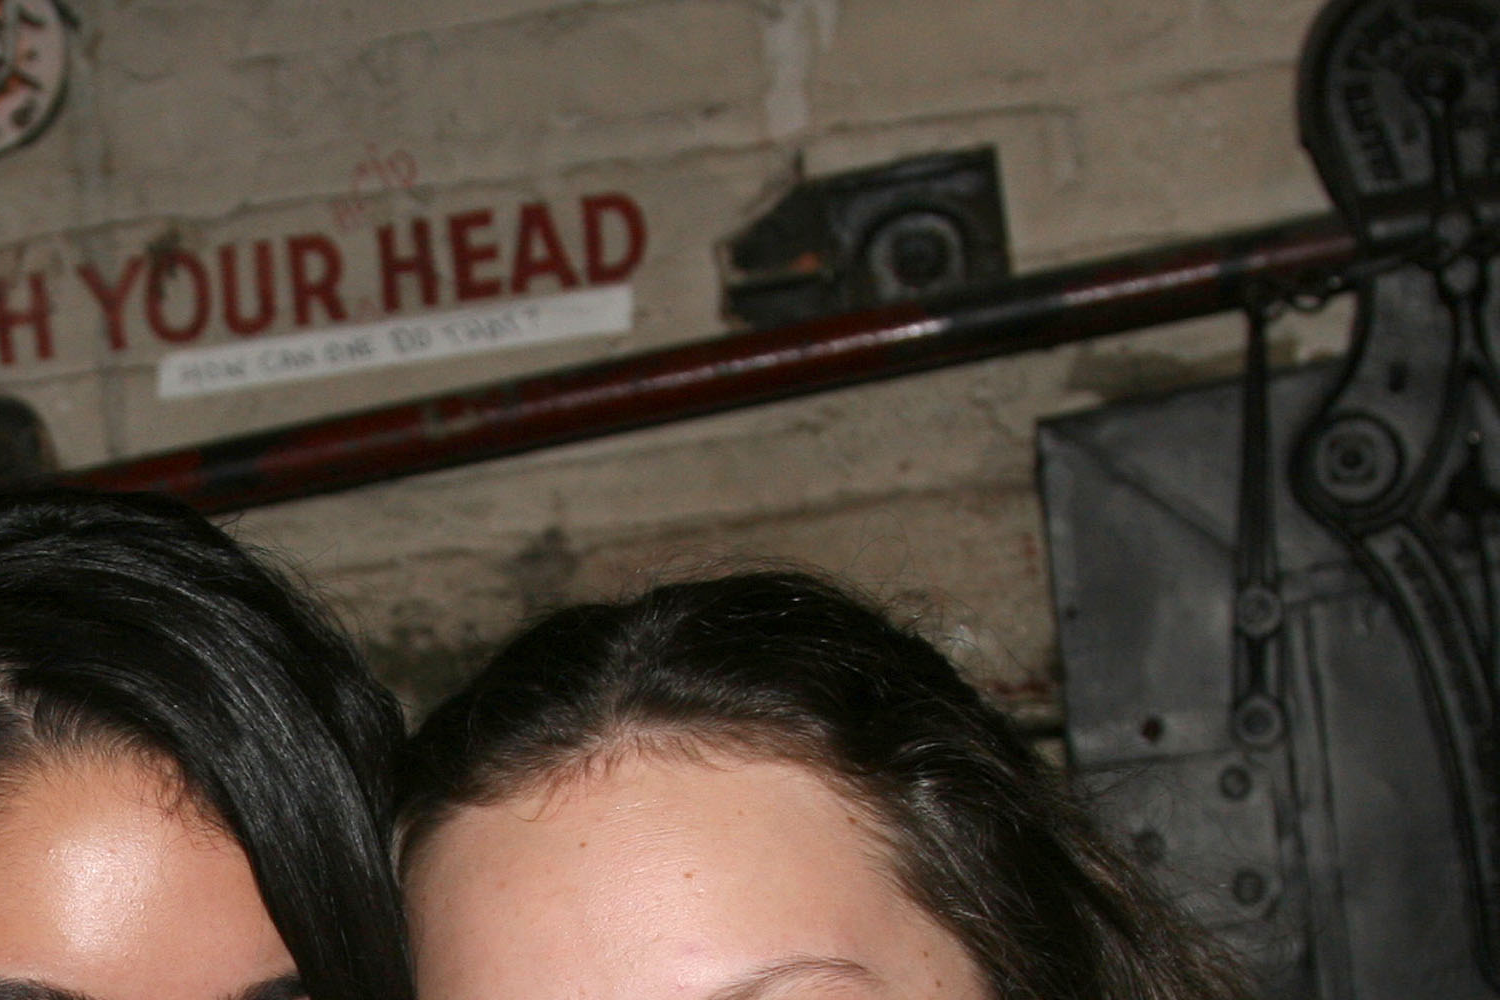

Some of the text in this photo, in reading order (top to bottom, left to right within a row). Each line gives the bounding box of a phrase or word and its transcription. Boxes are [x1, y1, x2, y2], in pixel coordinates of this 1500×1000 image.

[77, 232, 349, 347] YOUR
[376, 190, 649, 313] HEAD
[178, 352, 247, 387] HOW
[257, 343, 318, 373] CAN
[322, 332, 377, 363] ONE
[389, 321, 435, 354] DO
